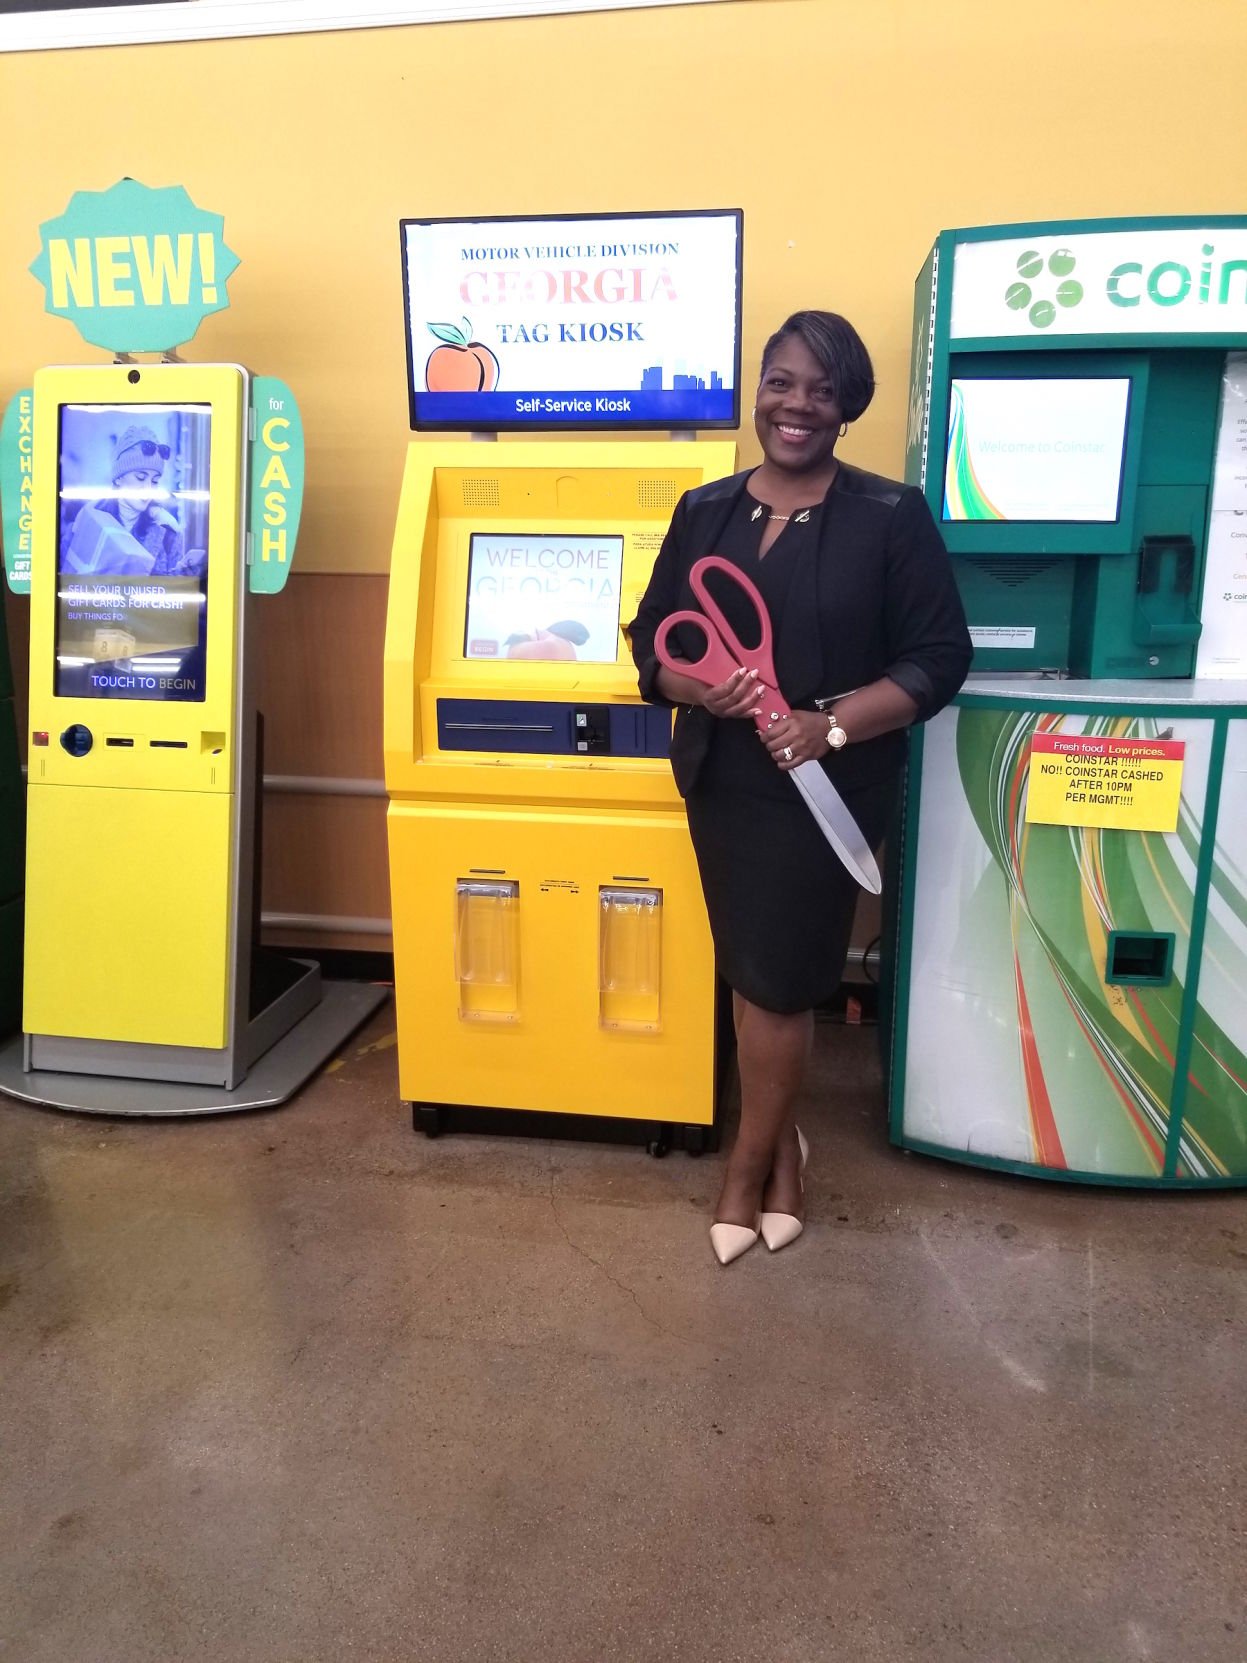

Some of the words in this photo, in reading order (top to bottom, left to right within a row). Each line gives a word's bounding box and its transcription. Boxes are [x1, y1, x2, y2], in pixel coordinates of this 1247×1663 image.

[461, 247, 520, 261] MOTOR
[524, 245, 597, 260] VEHICLE
[601, 242, 680, 257] DIVISION
[49, 232, 218, 308] NEW!
[459, 266, 679, 306] GEORGIA
[496, 323, 550, 344] TAG
[558, 321, 645, 343] KIOSK
[269, 397, 284, 411] for
[515, 398, 592, 412] Self-Service
[595, 397, 631, 412] Kiosk
[978, 440, 1035, 453] Welcome
[1038, 440, 1051, 453] to
[1054, 440, 1105, 453] Coinstar
[18, 396, 32, 550] EXCHANGE
[260, 417, 291, 563] CASH
[486, 547, 610, 569] WELCOME
[67, 584, 89, 595] SELL
[92, 584, 121, 596] YOUR
[123, 585, 166, 597] UNUSED
[67, 597, 90, 607] GIFT
[92, 598, 126, 608] CARDS
[128, 599, 149, 609] FOR
[150, 599, 184, 610] CASH!
[67, 612, 82, 620] BUY
[84, 612, 111, 621] THINGS
[91, 675, 135, 688] TOUCH
[138, 677, 156, 689] TO
[159, 678, 196, 690] BEGIN
[1053, 741, 1080, 752] Fresh
[1081, 743, 1105, 753] food.
[1108, 745, 1131, 755] Low
[1131, 746, 1166, 757] prices.
[1065, 754, 1118, 766] COINSTAR
[1040, 764, 1063, 775] NO!!
[1065, 766, 1118, 779] COINSTAR
[1120, 769, 1164, 782] CASHED
[1069, 779, 1103, 790] AFTER
[1106, 781, 1133, 792] 10PM
[1065, 792, 1086, 803] PER
[1088, 795, 1133, 806] MGMT!!!!
